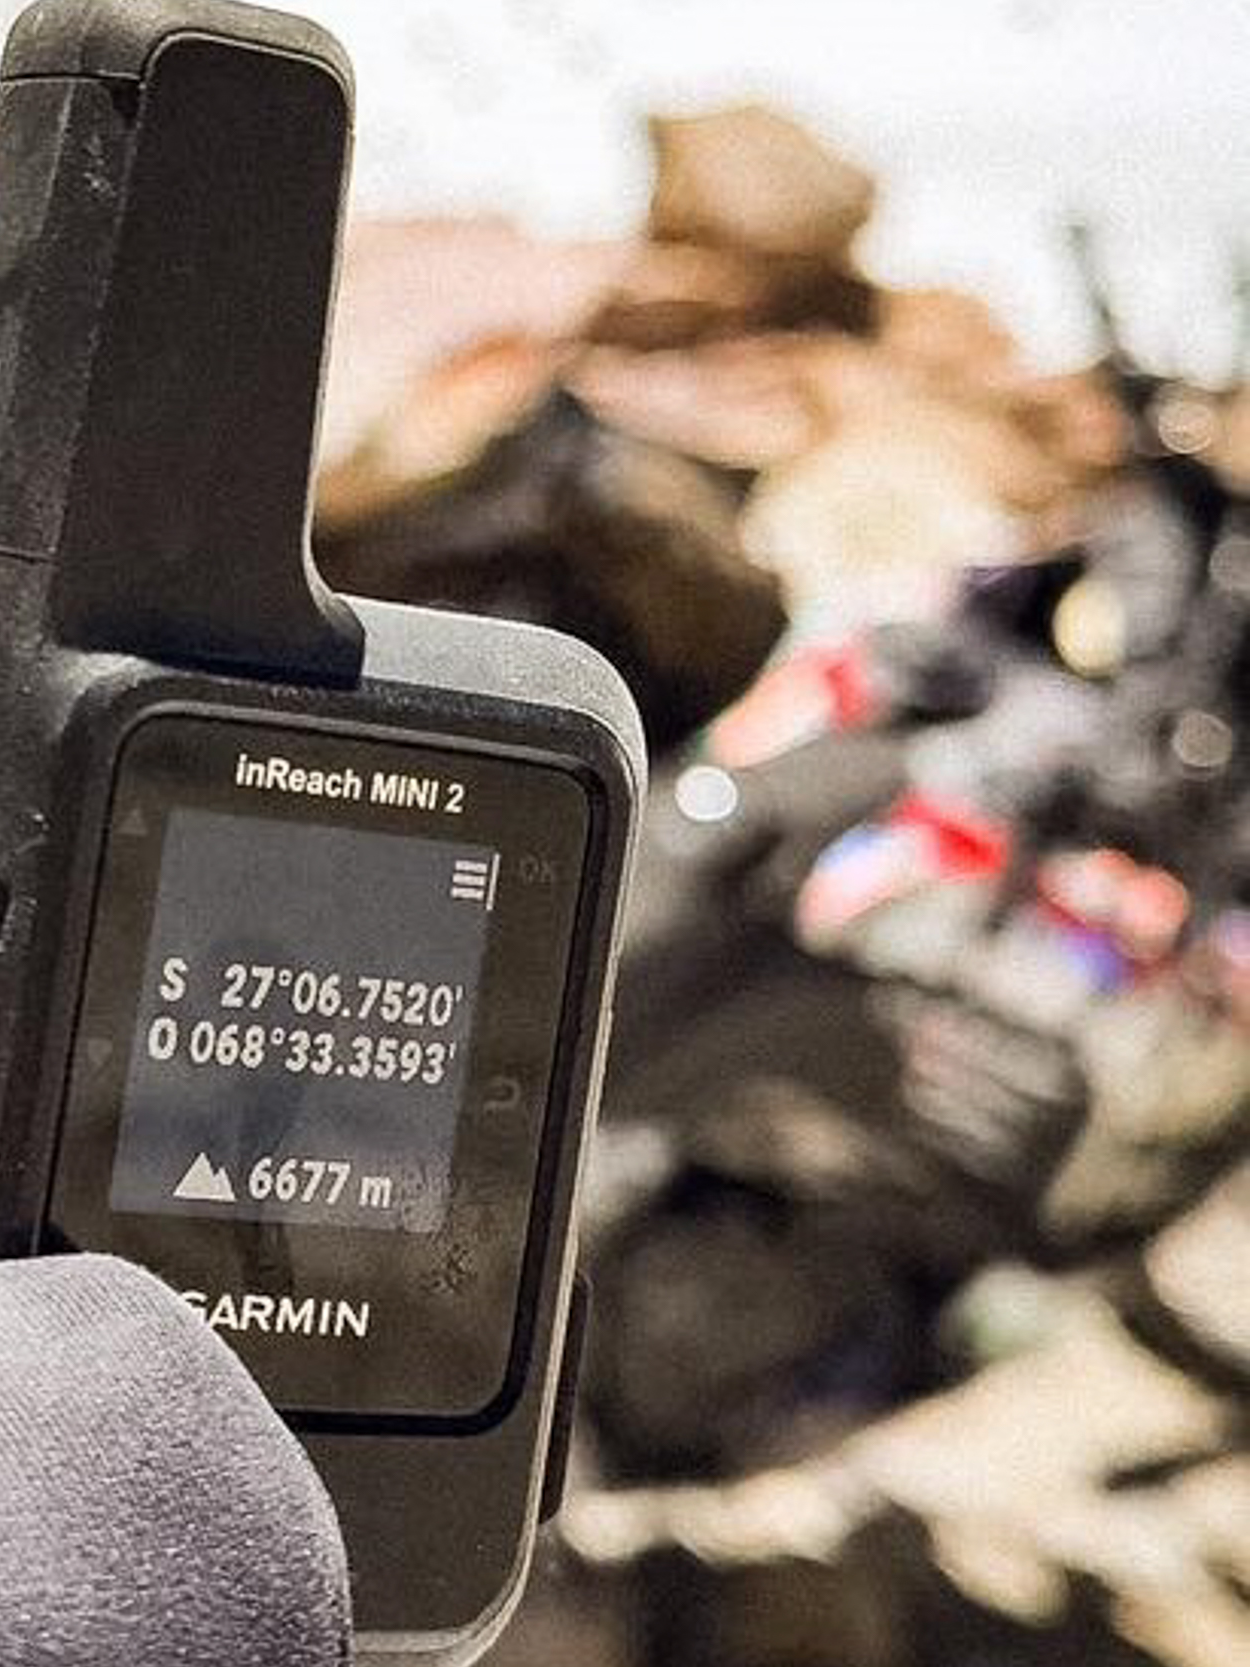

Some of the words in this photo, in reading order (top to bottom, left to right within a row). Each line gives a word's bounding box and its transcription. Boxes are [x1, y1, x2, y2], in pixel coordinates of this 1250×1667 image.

[236, 753, 362, 800] inReach
[370, 772, 439, 810] MINI
[444, 784, 464, 813] 2
[160, 957, 188, 1002] S
[221, 963, 463, 1027] 27°06.7520'
[190, 1020, 457, 1085] 068°33.3593'
[250, 1156, 351, 1206] 6677
[359, 1176, 392, 1208] m
